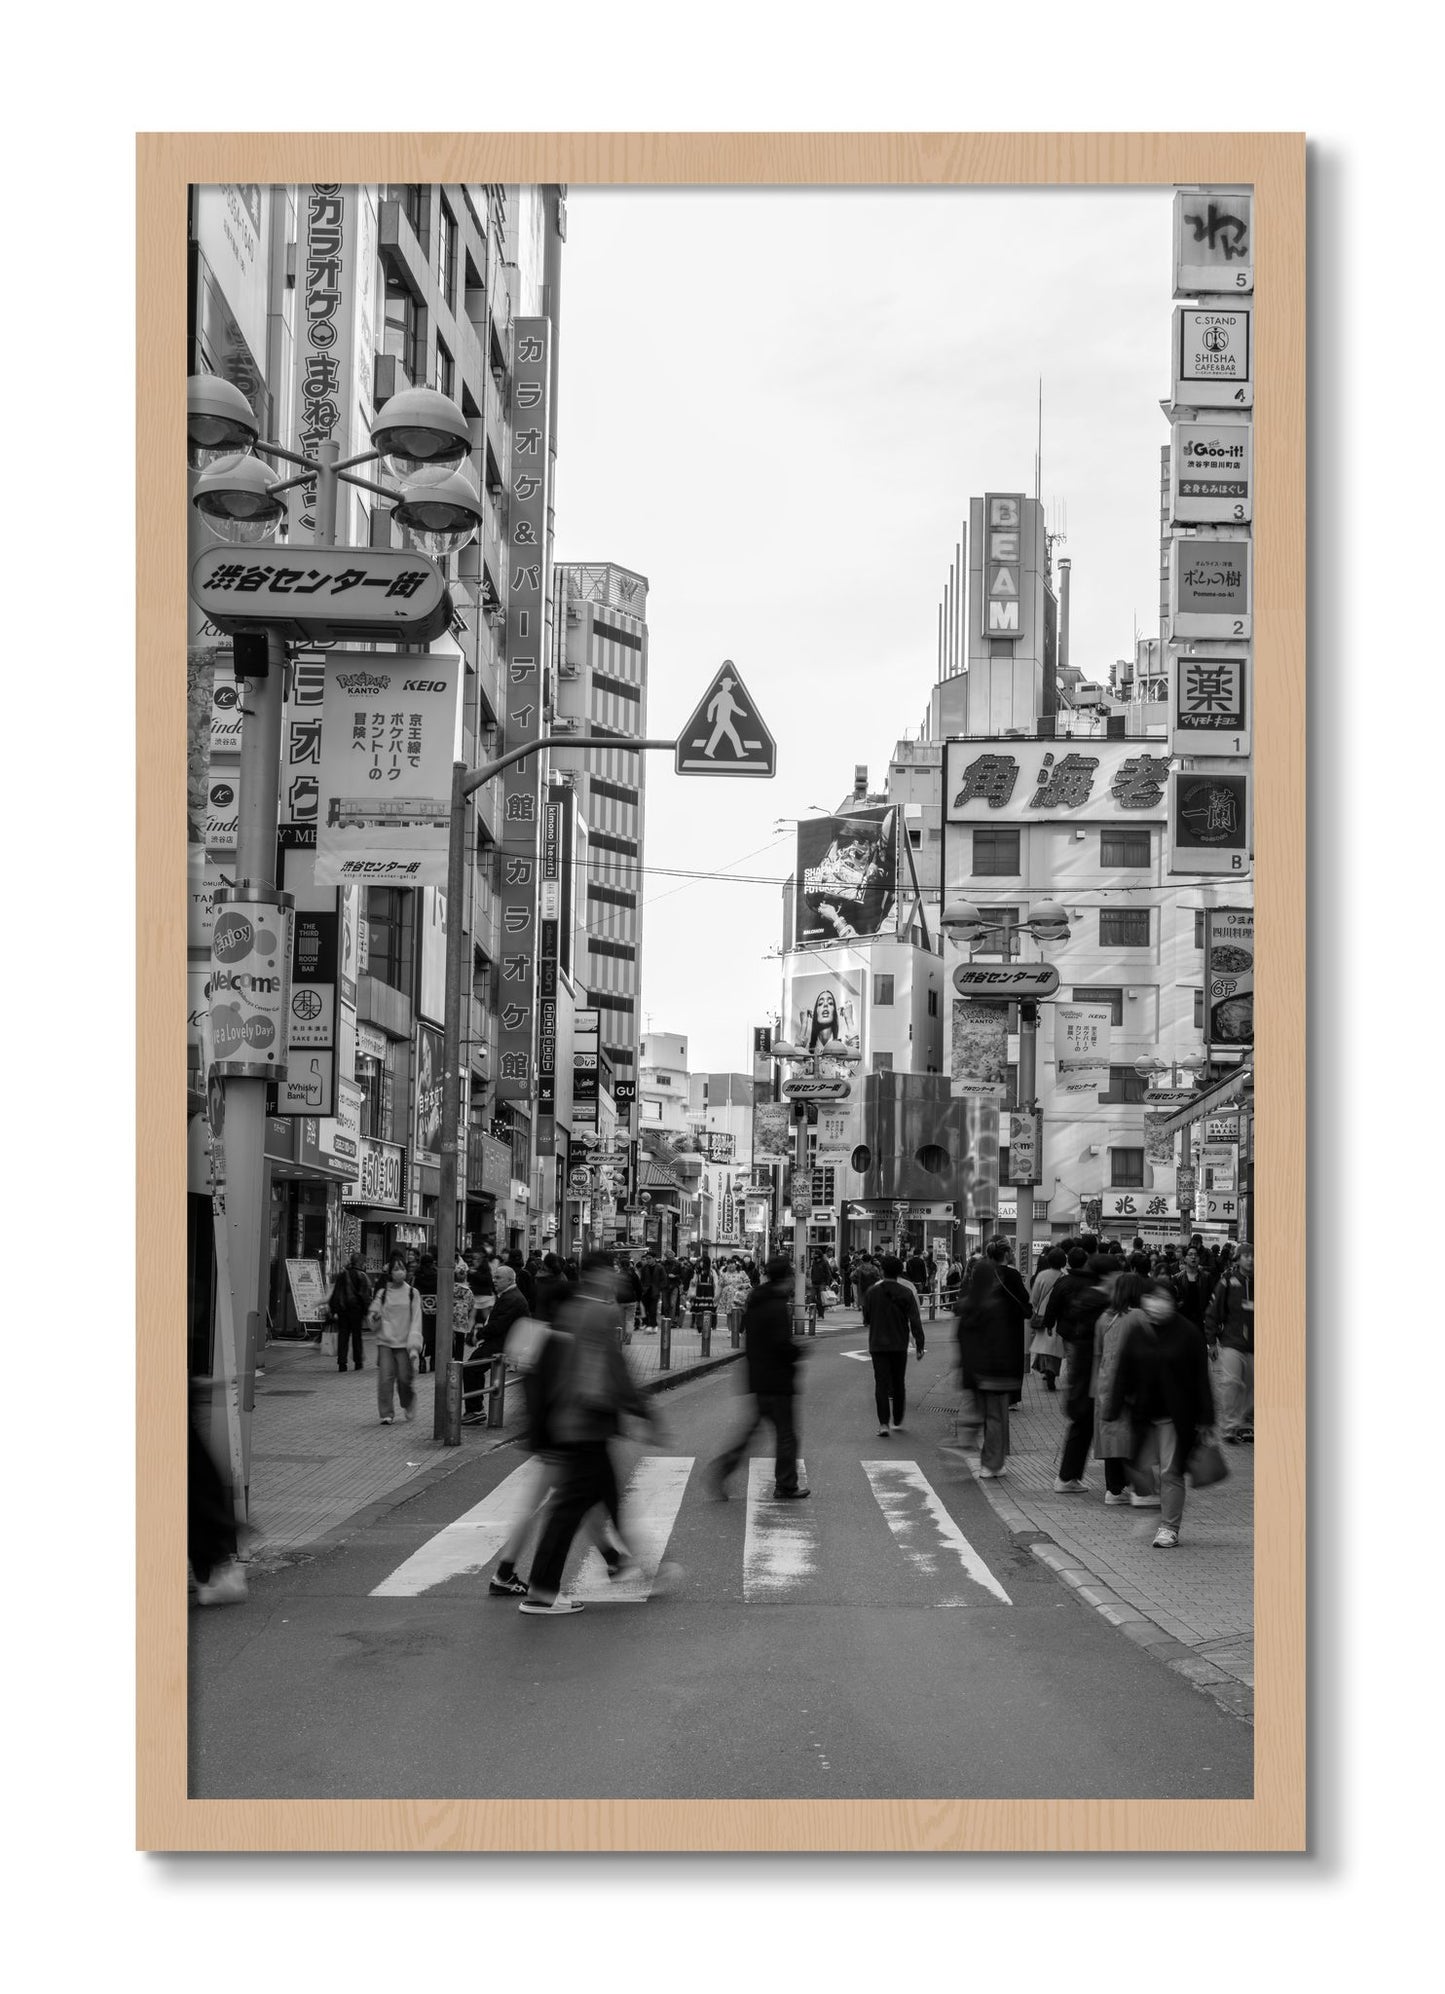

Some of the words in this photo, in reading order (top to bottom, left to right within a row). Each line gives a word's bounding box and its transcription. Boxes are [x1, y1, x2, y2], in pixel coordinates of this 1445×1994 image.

[307, 196, 344, 321] カラオケ
[1236, 273, 1247, 288] 5
[1195, 316, 1237, 326] C.STAND
[1195, 353, 1236, 363] SHISHA
[1195, 364, 1236, 372] CAFE&BAR
[1194, 442, 1243, 457] Goo-it!
[1187, 460, 1241, 470] 渋谷宇田川町店
[1183, 484, 1245, 495] 全身もみほぐし
[1233, 504, 1245, 519] 3
[990, 498, 1019, 630] BEAM
[203, 564, 430, 598] 渋谷センター街
[1184, 570, 1242, 587] ポムの樹
[1233, 621, 1244, 635] 2
[347, 686, 380, 695] KANTO
[402, 679, 447, 693] KEIO
[1187, 665, 1233, 711] 薬
[351, 712, 366, 752] 冒険へ
[369, 712, 385, 781] カントーの
[407, 713, 423, 768] 京王線で
[1233, 738, 1240, 752] 1
[953, 753, 1173, 808] 角海老
[1181, 788, 1237, 833] 一蘭
[547, 807, 556, 840] kimono
[340, 861, 422, 873] 渋谷センター街
[547, 844, 556, 876] hearts
[1231, 855, 1242, 870] B
[214, 924, 252, 956] Enjoy
[301, 965, 316, 973] BAR
[211, 969, 281, 994] Welcome
[960, 971, 1054, 983] 渋谷センター街
[1211, 979, 1238, 998] 6F
[226, 1023, 254, 1042] Lovely
[255, 1024, 275, 1037] Day!
[288, 1082, 319, 1093] Whisky
[616, 1086, 634, 1097] GU
[785, 1083, 843, 1092] 渋谷センター街
[287, 1091, 306, 1100] Bank
[1147, 1092, 1199, 1100] 渋谷センター街
[724, 1194, 733, 1232] BEER
[1114, 1195, 1169, 1216] 兆楽
